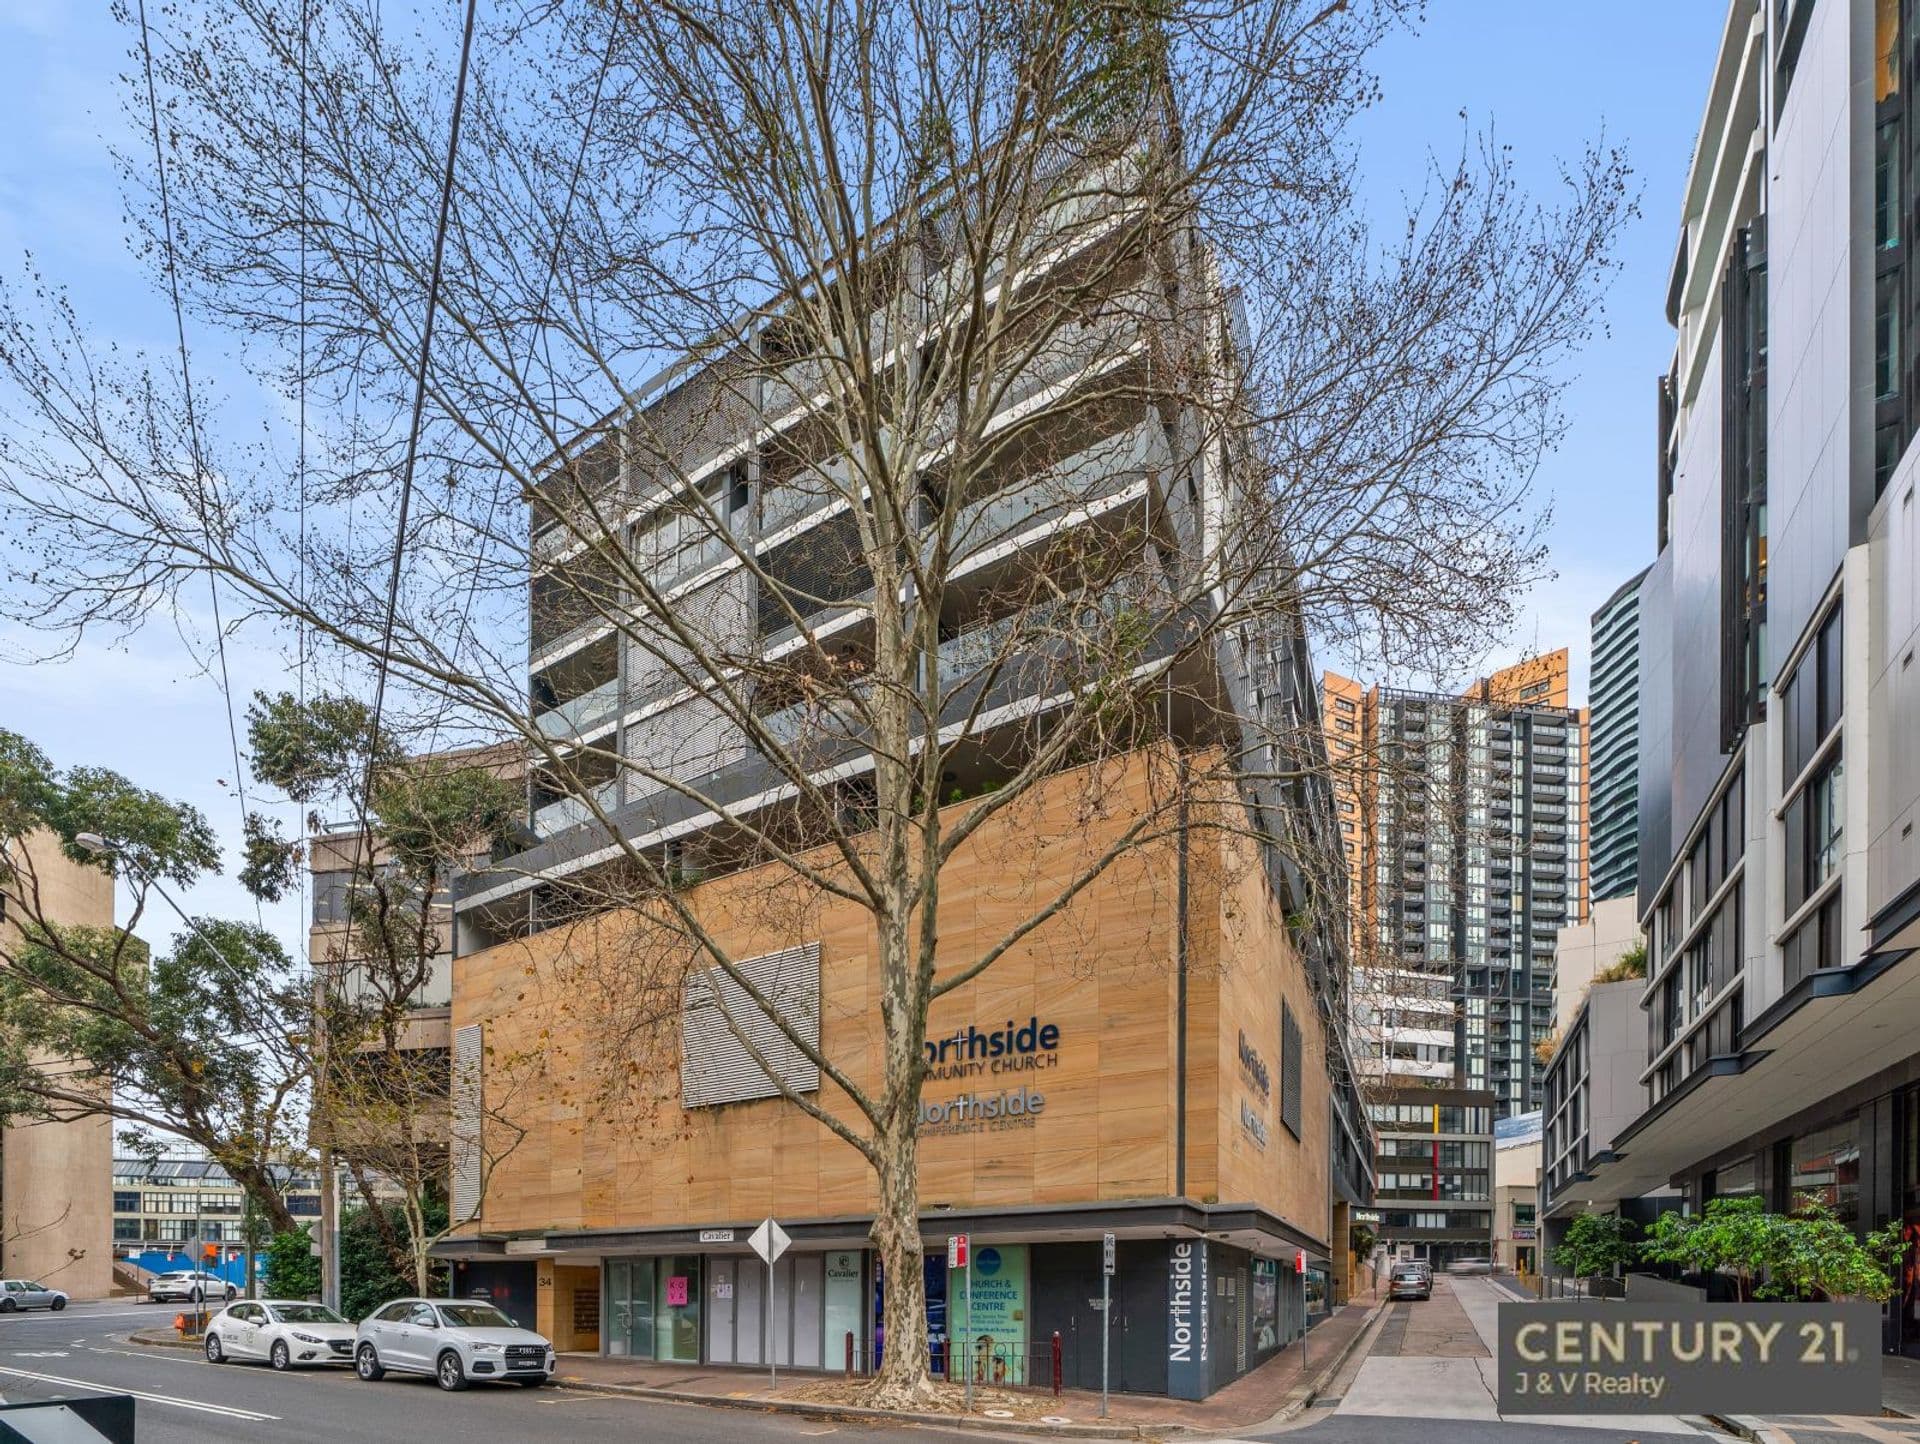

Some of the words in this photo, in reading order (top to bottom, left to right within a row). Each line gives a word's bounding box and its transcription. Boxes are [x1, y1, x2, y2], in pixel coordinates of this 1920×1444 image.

[923, 1016, 1060, 1063] orthside
[991, 1053, 1058, 1074] CHURCH
[702, 1231, 731, 1241] Cavalier
[828, 1268, 859, 1279] Cavalier
[539, 1277, 552, 1287] 34
[970, 1279, 1002, 1288] HURCH
[1004, 1279, 1011, 1288] &
[960, 1290, 1018, 1300] CNFERENCE
[971, 1302, 1006, 1311] CENTRE
[1169, 1242, 1191, 1362] Northside
[1200, 1242, 1208, 1362] Northside
